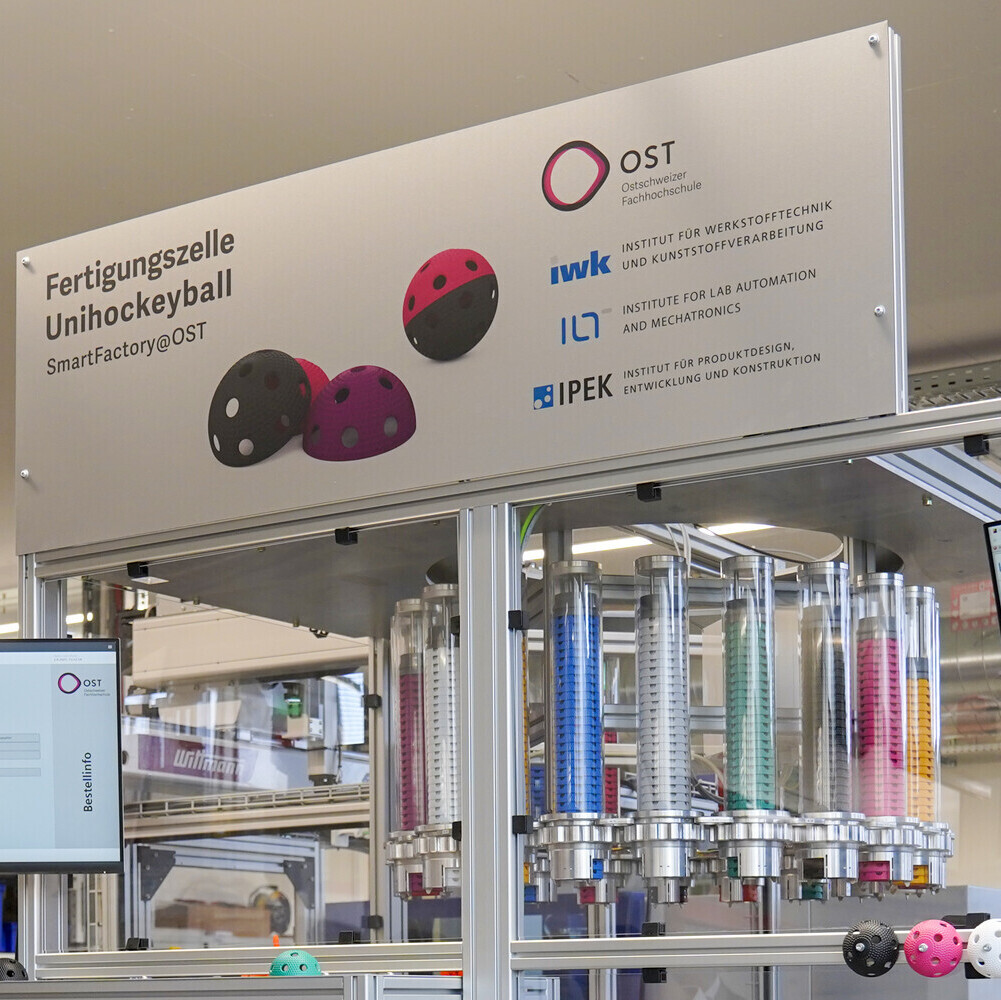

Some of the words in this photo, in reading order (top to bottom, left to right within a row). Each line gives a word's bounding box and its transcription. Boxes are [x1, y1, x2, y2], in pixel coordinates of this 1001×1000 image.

[620, 141, 675, 174] OST
[621, 170, 687, 193] Ostschweizer
[621, 181, 702, 206] Fachhochschule
[622, 233, 674, 253] INSTITUT
[678, 227, 701, 241] FÜR
[704, 200, 833, 236] WERKSTOFFTECHNIK
[622, 257, 647, 270] UND
[652, 220, 824, 264] KUNSTSTOFFVERARBEITUNG
[46, 229, 235, 300] Fertigungszelle
[550, 250, 611, 285] iwk
[46, 269, 232, 340] Unihockeyball
[622, 295, 679, 315] INSTITUTE
[683, 290, 706, 303] FOR
[710, 285, 732, 299] LAB
[736, 269, 816, 293] AUTOMATION
[623, 320, 647, 334] AND
[651, 303, 741, 328] MECHATRONICS
[46, 322, 207, 375] SmartFactory@OST
[624, 363, 670, 379] INSTITUT
[674, 358, 694, 371] FÜR
[698, 341, 795, 366] PRODUKTDESIGN,
[559, 373, 613, 405] IPEK
[624, 373, 701, 395] ENTWICKLUNG
[705, 368, 728, 381] UND
[733, 353, 821, 376] KONSTRUKTION
[83, 679, 102, 687] OST
[82, 752, 93, 812] Bestellinfo
